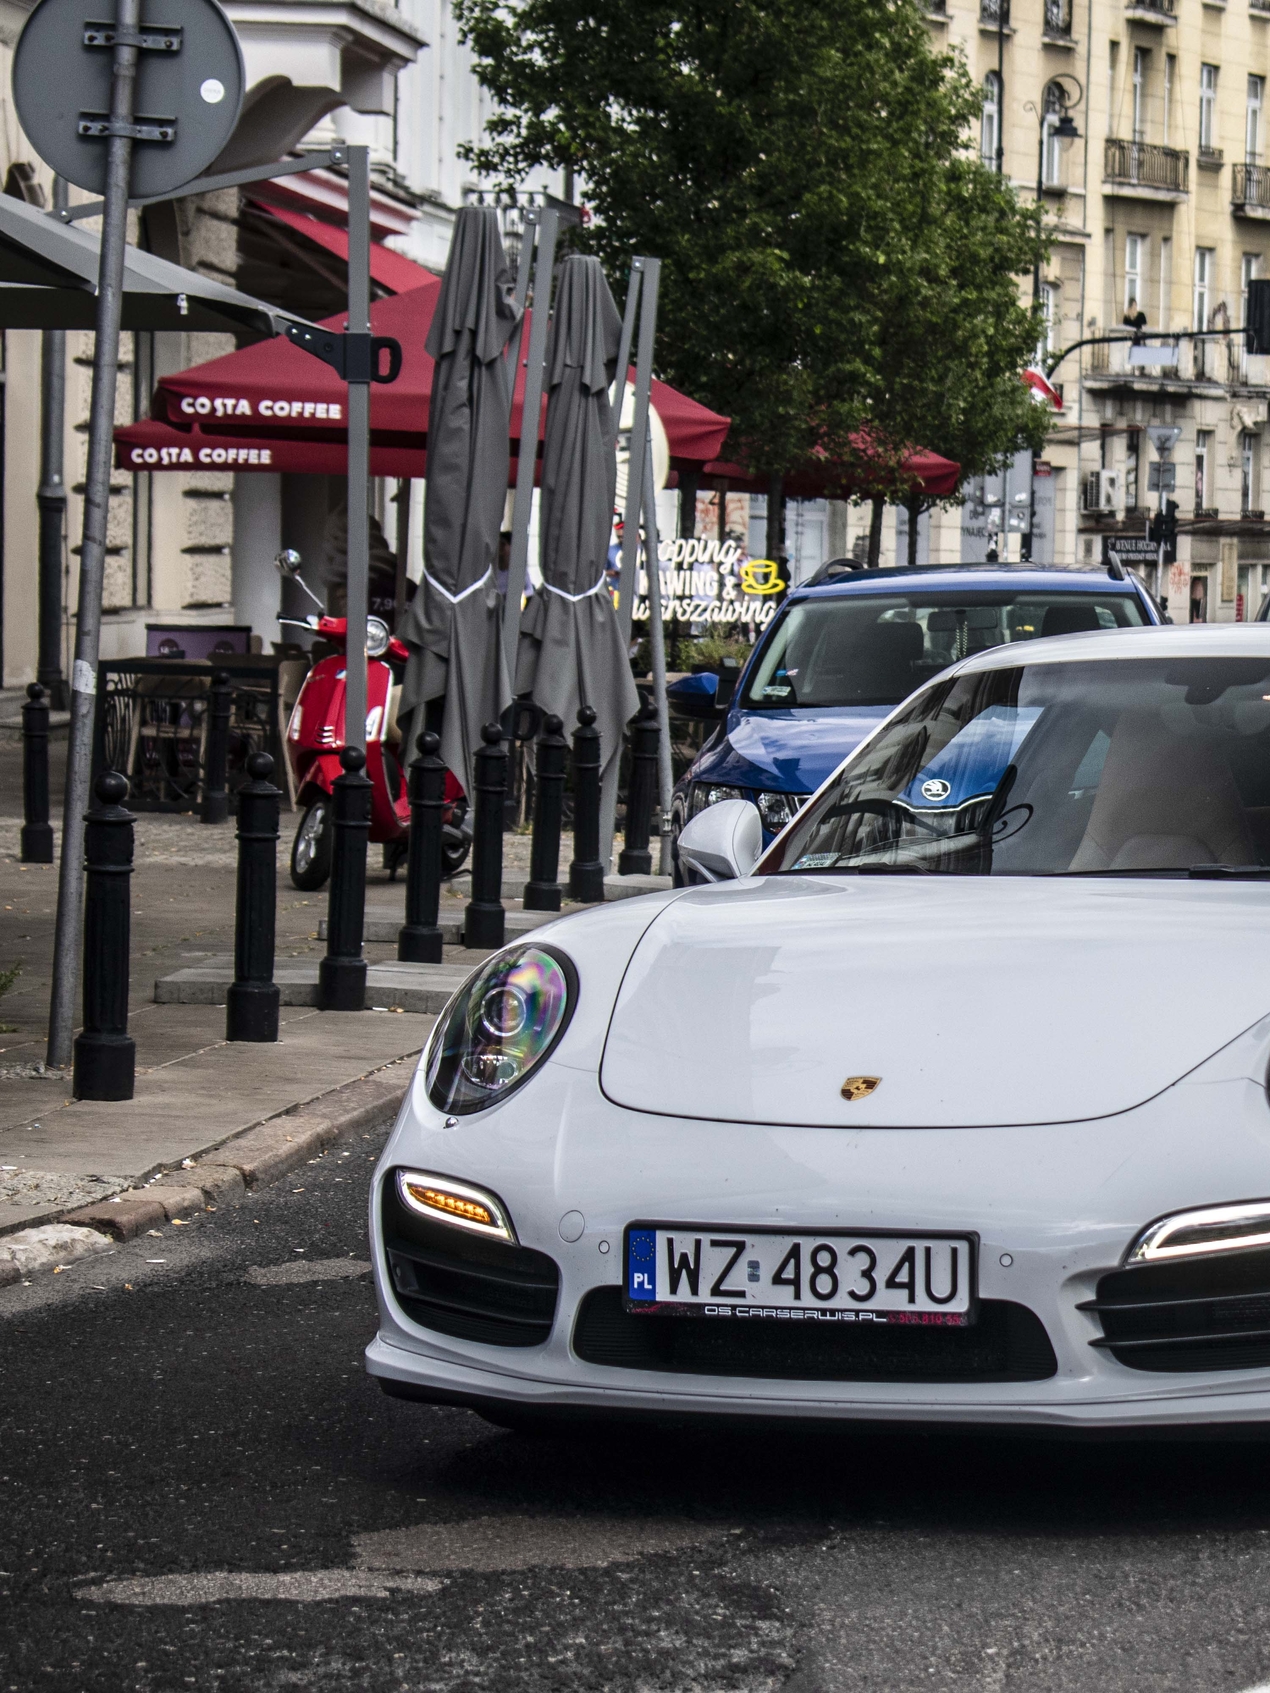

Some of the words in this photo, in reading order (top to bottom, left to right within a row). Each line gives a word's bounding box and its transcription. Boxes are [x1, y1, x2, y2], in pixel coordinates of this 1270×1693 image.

[181, 397, 252, 417] COSTA
[258, 399, 342, 419] COFFEE
[131, 447, 194, 465] COSTA
[198, 448, 272, 464] COFFEE
[722, 576, 738, 600] &
[633, 1273, 653, 1290] PL
[666, 1236, 748, 1298] WZ
[771, 1240, 959, 1305] 4834U
